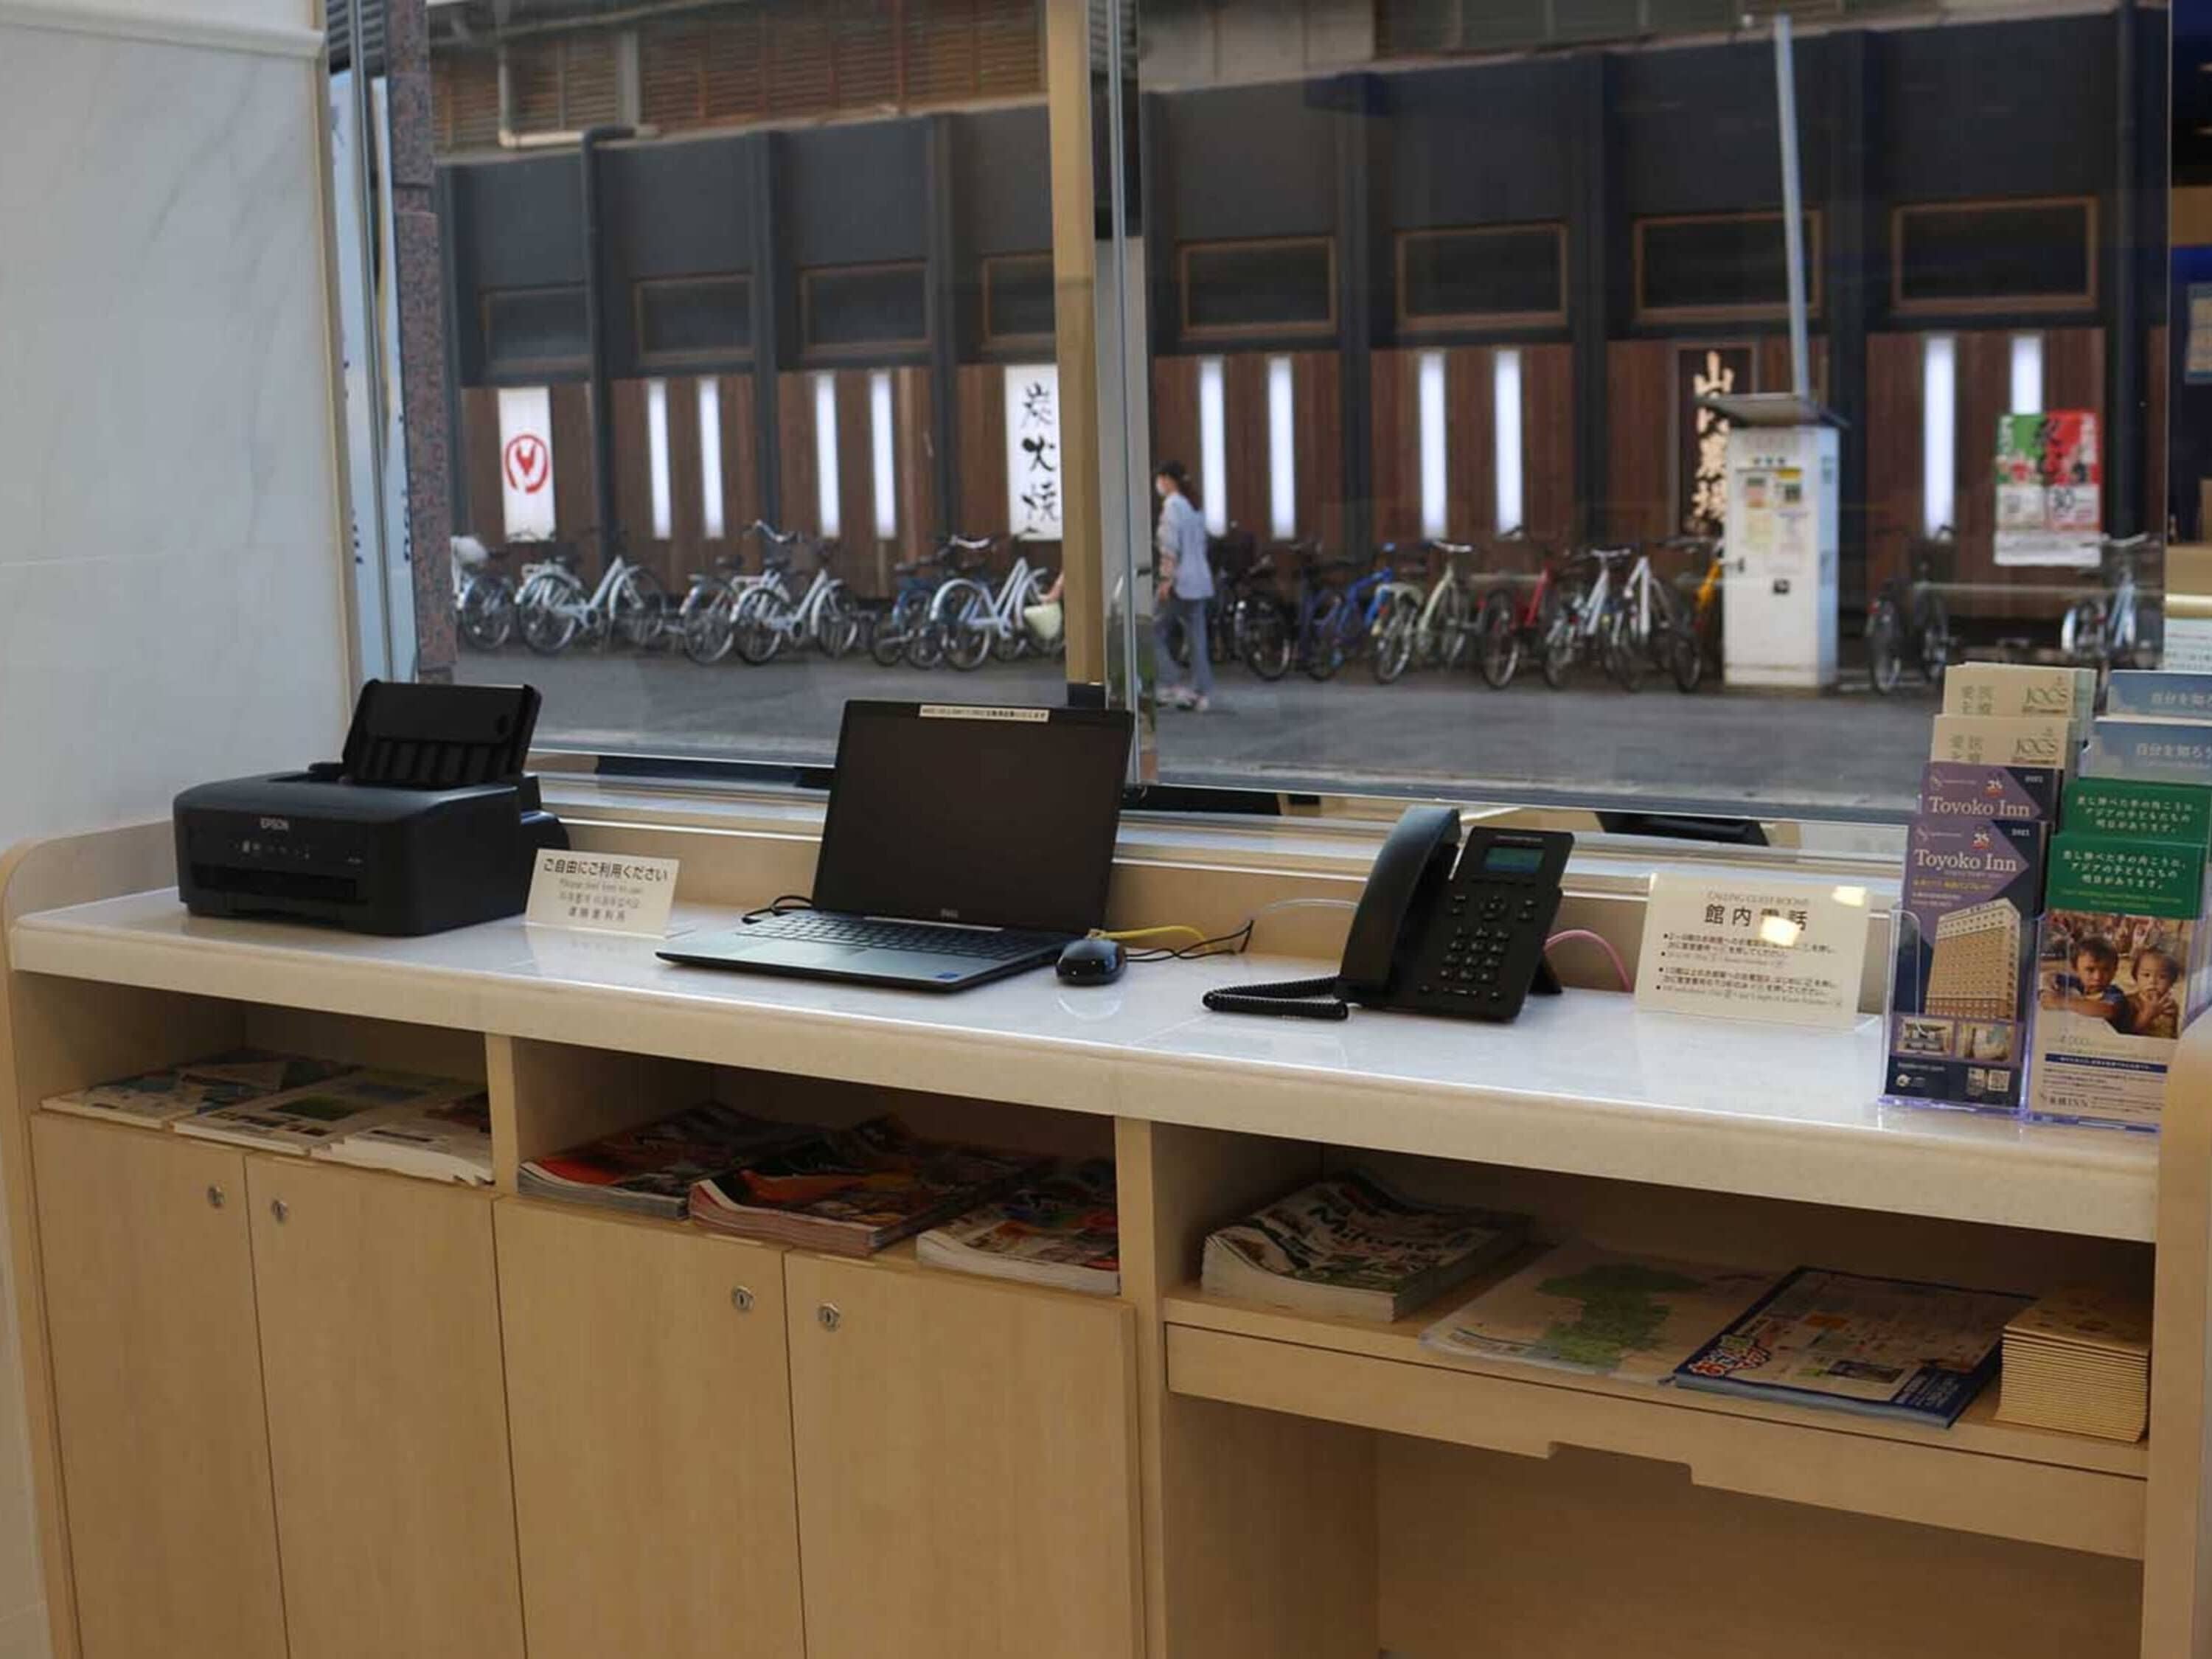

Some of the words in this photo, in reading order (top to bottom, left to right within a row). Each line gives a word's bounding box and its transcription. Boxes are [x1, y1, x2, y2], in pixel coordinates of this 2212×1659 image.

[1999, 799, 2030, 817] Inn
[543, 858, 668, 882] ご自由にご利用ください
[1913, 849, 1981, 871] Toyoko
[1985, 852, 2017, 872] Inn
